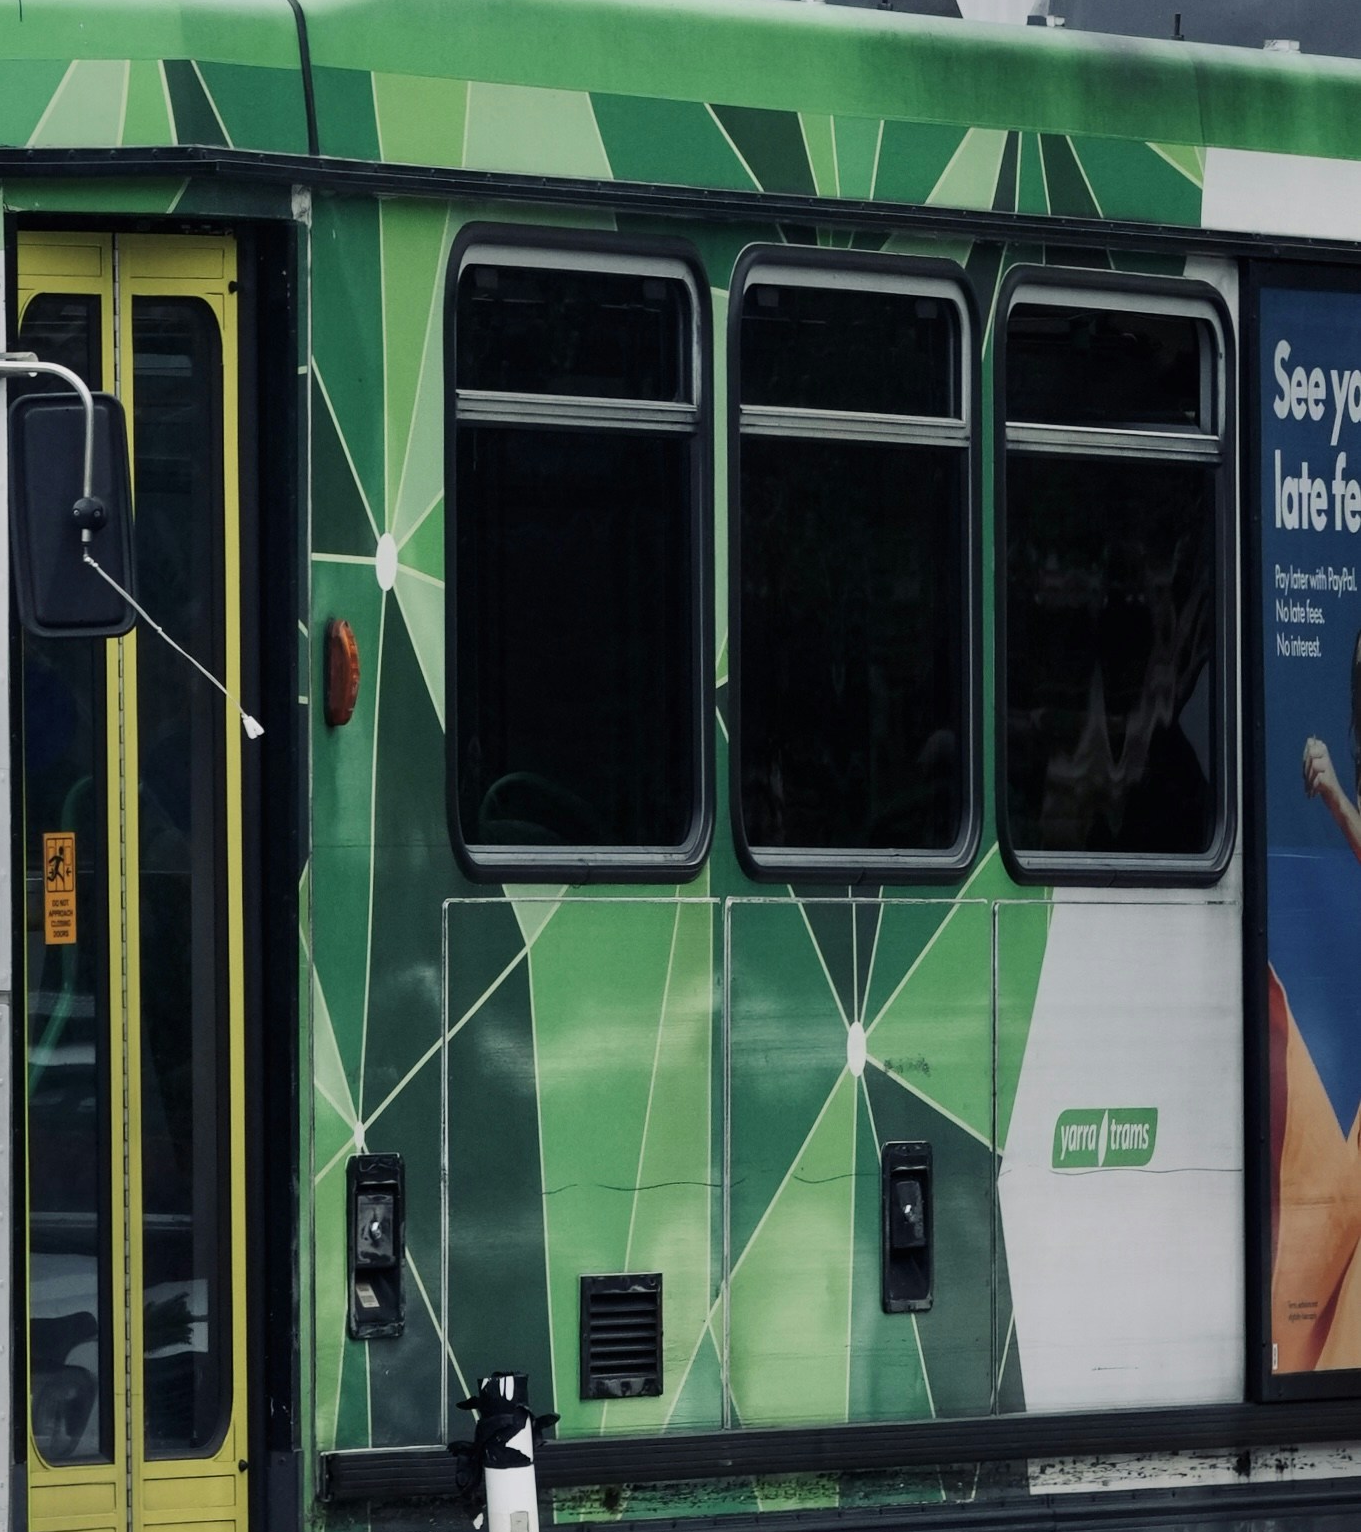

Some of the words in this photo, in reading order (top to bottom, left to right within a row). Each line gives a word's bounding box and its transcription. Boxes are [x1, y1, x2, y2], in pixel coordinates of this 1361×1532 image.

[1273, 339, 1327, 421] See
[1274, 449, 1328, 532] late
[1275, 564, 1290, 596] Pay
[1290, 564, 1309, 590] later
[1309, 566, 1327, 591] with
[1276, 598, 1289, 623] No
[1290, 598, 1305, 624] late
[1306, 599, 1325, 625] fees.
[1276, 632, 1290, 657] No
[1291, 635, 1322, 658] interest.
[1060, 1124, 1098, 1161] yarra
[1110, 1118, 1151, 1151] trams
